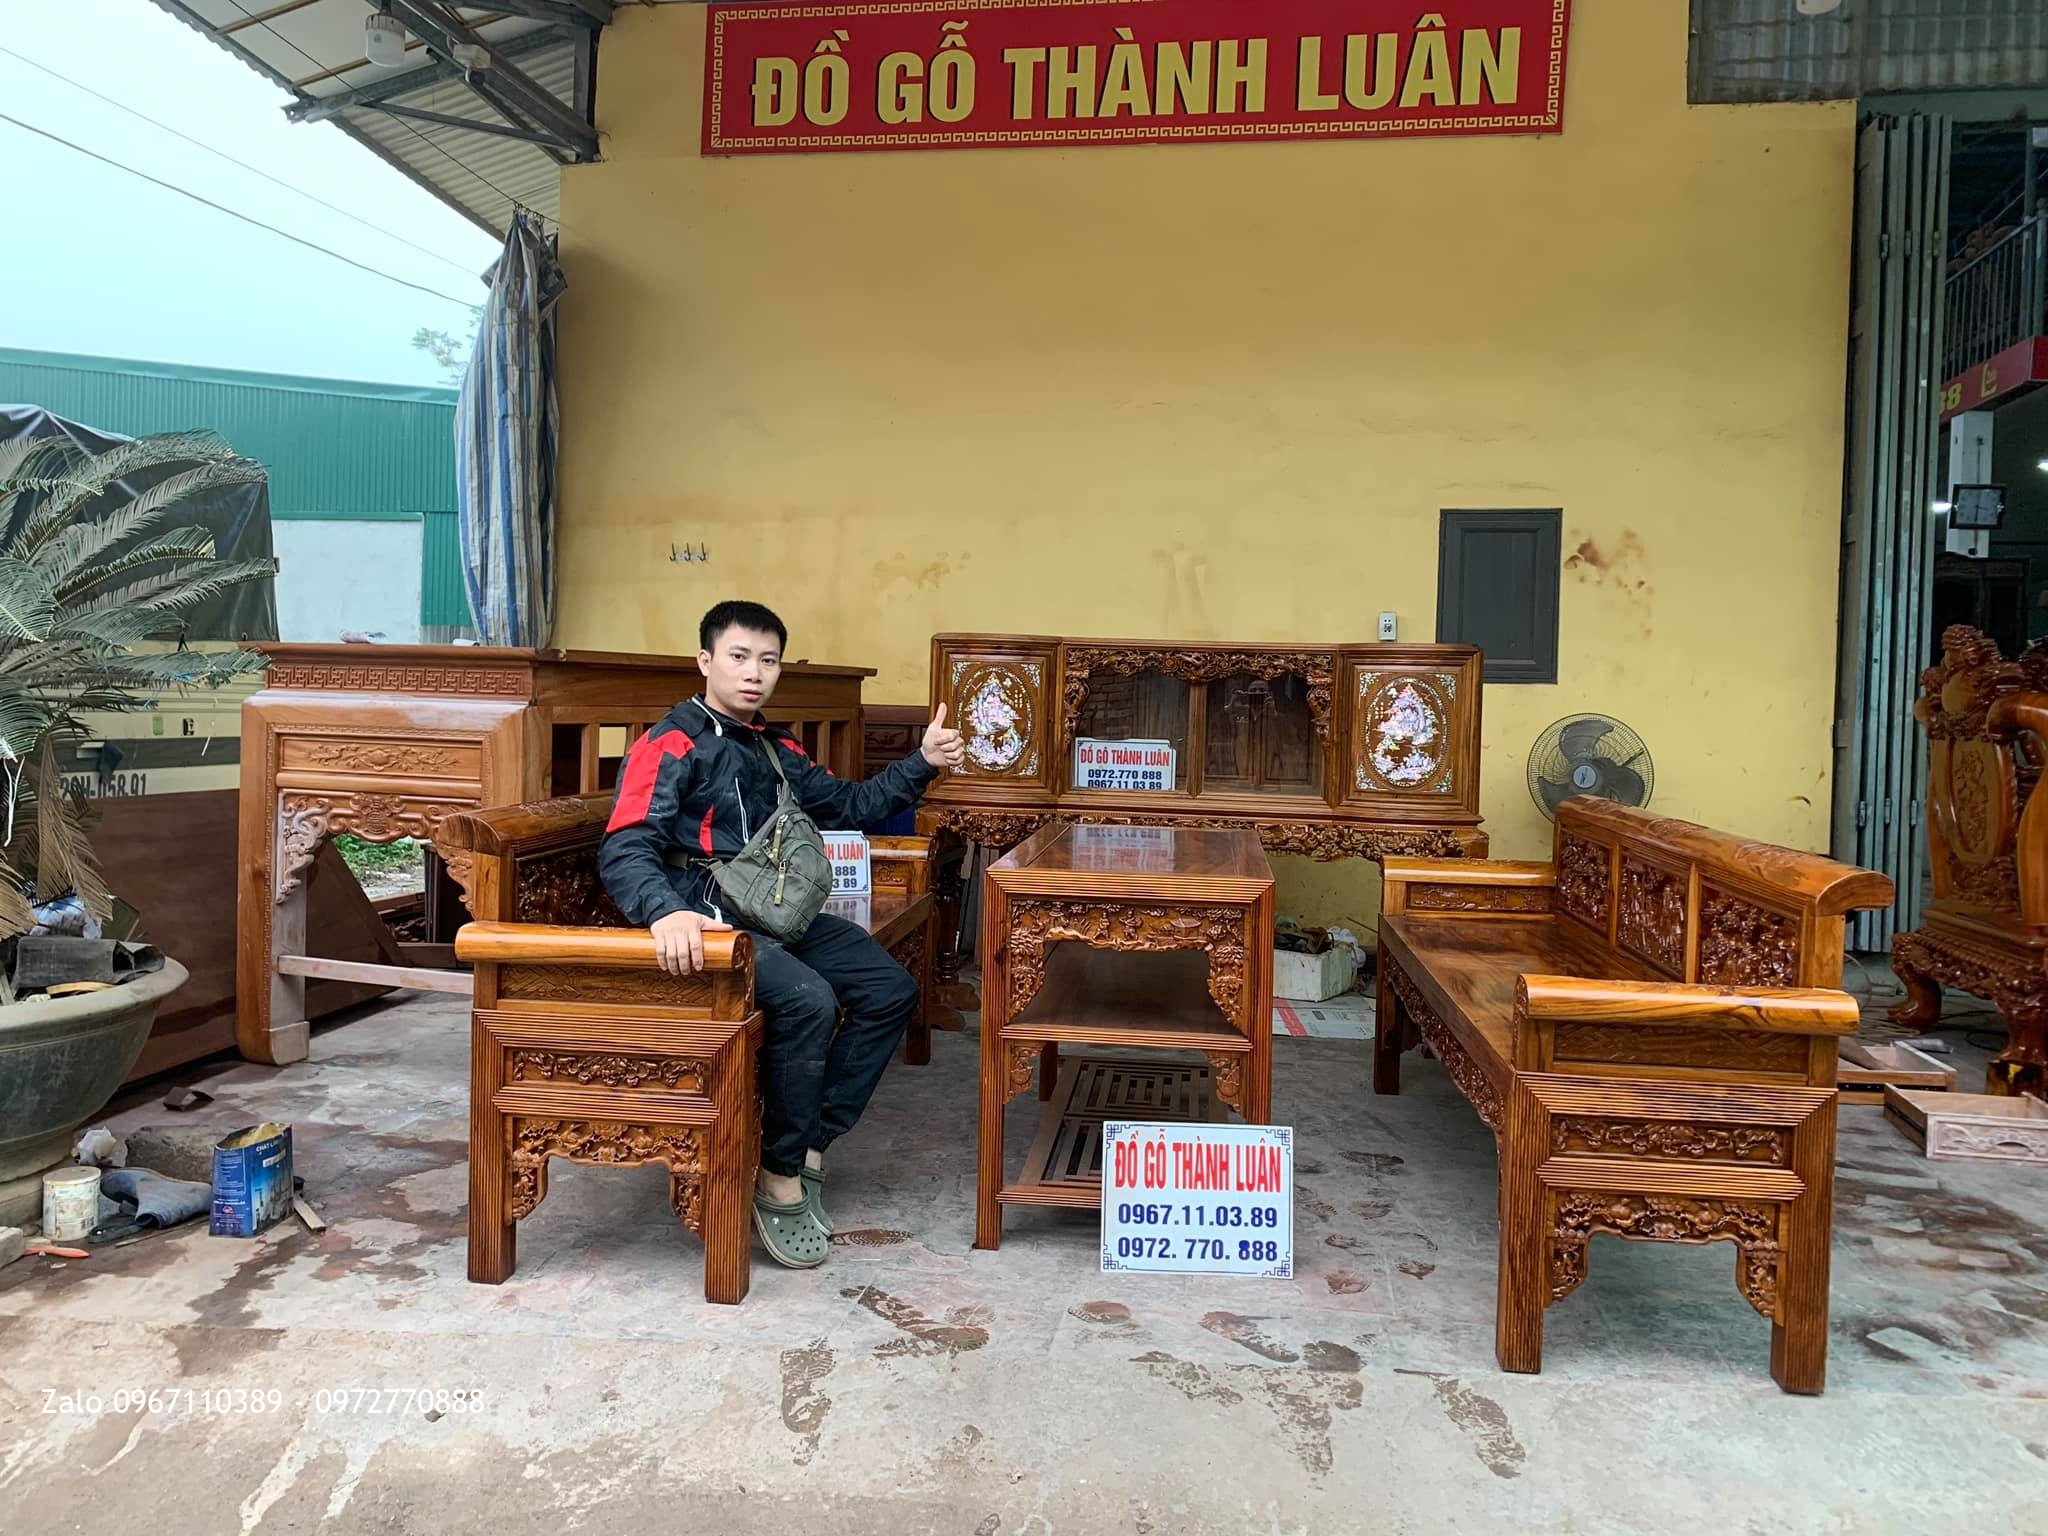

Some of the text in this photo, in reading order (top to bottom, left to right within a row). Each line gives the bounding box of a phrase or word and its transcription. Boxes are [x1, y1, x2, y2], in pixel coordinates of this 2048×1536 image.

[751, 13, 1521, 127] ĐỒ GỖ THÀNH LUÂN
[835, 866, 857, 877] 888
[843, 878, 858, 889] 89
[1144, 1128, 1167, 1190] GỖ
[1172, 1136, 1230, 1191] THÀNH
[1236, 1137, 1282, 1193] LUÂN
[1118, 1203, 1278, 1228] 0967.11.03.89
[1118, 1237, 1278, 1261] 0972. 770. 888
